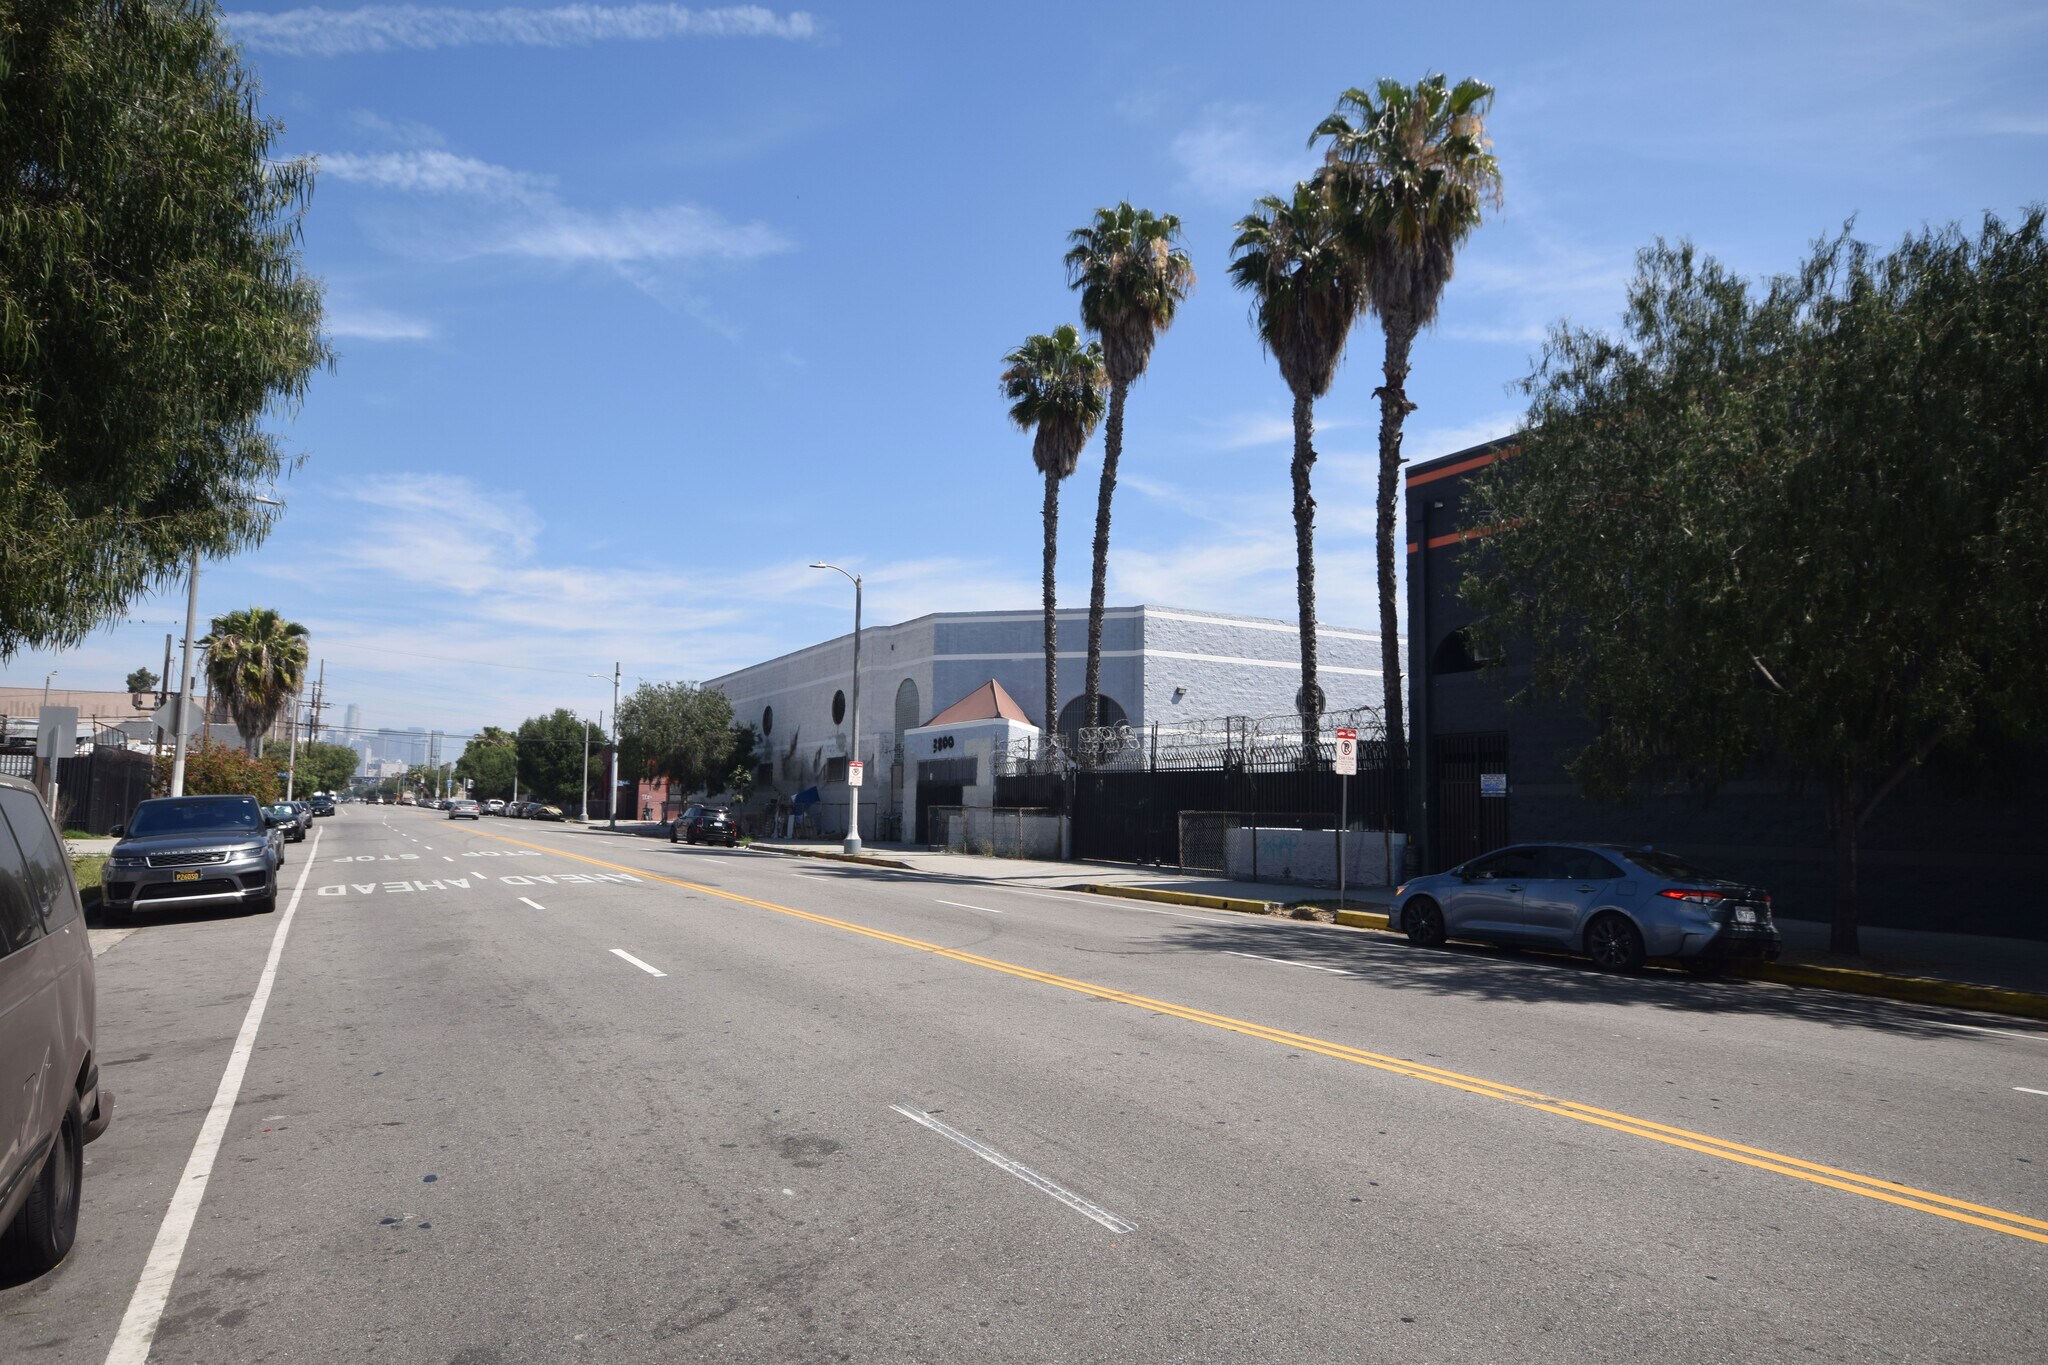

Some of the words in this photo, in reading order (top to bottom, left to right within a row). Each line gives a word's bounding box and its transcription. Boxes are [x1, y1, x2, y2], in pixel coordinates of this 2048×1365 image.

[933, 735, 954, 754] 3800
[334, 853, 420, 863] STOP
[499, 873, 644, 885] AHEAD
[317, 878, 471, 896] AHEAD
